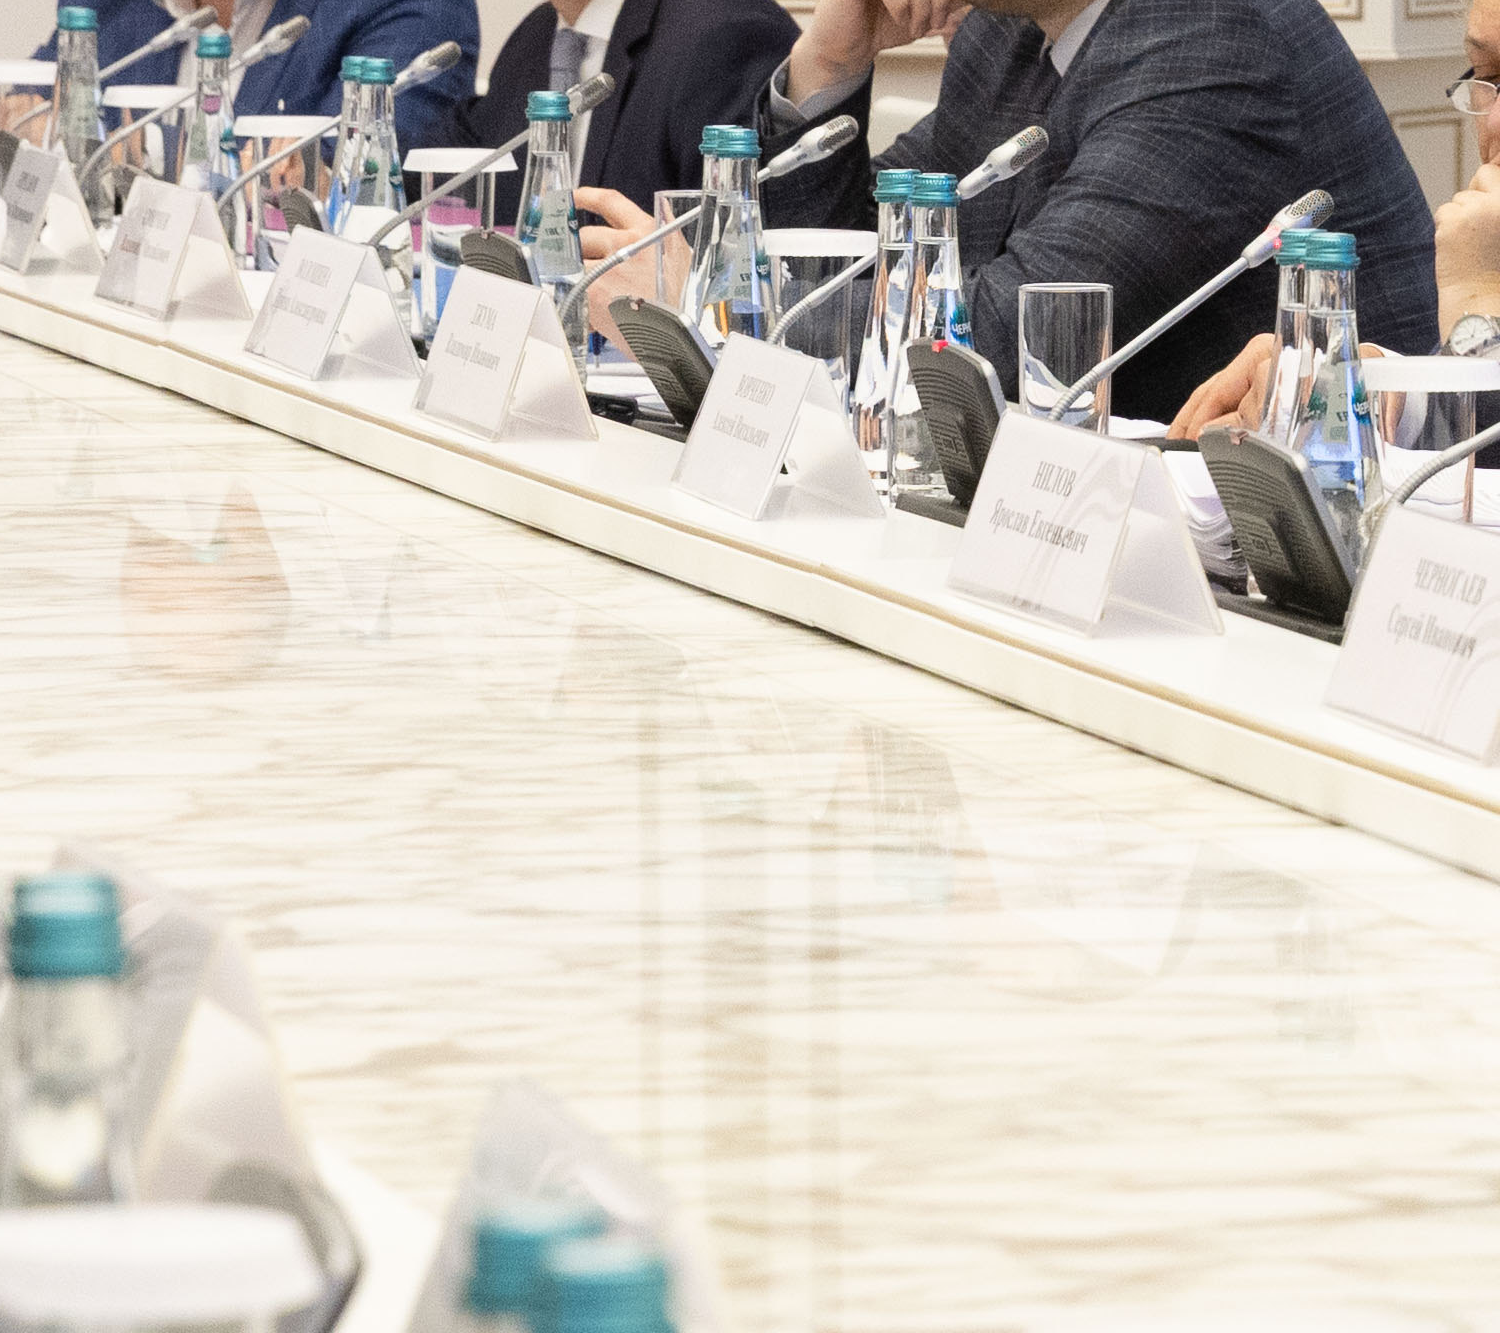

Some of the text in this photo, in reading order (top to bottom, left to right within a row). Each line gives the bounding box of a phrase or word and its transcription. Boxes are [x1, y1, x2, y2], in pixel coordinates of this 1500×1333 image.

[1032, 461, 1077, 497] НИЛОВ
[989, 498, 1089, 555] Ярослав Евгеньевич
